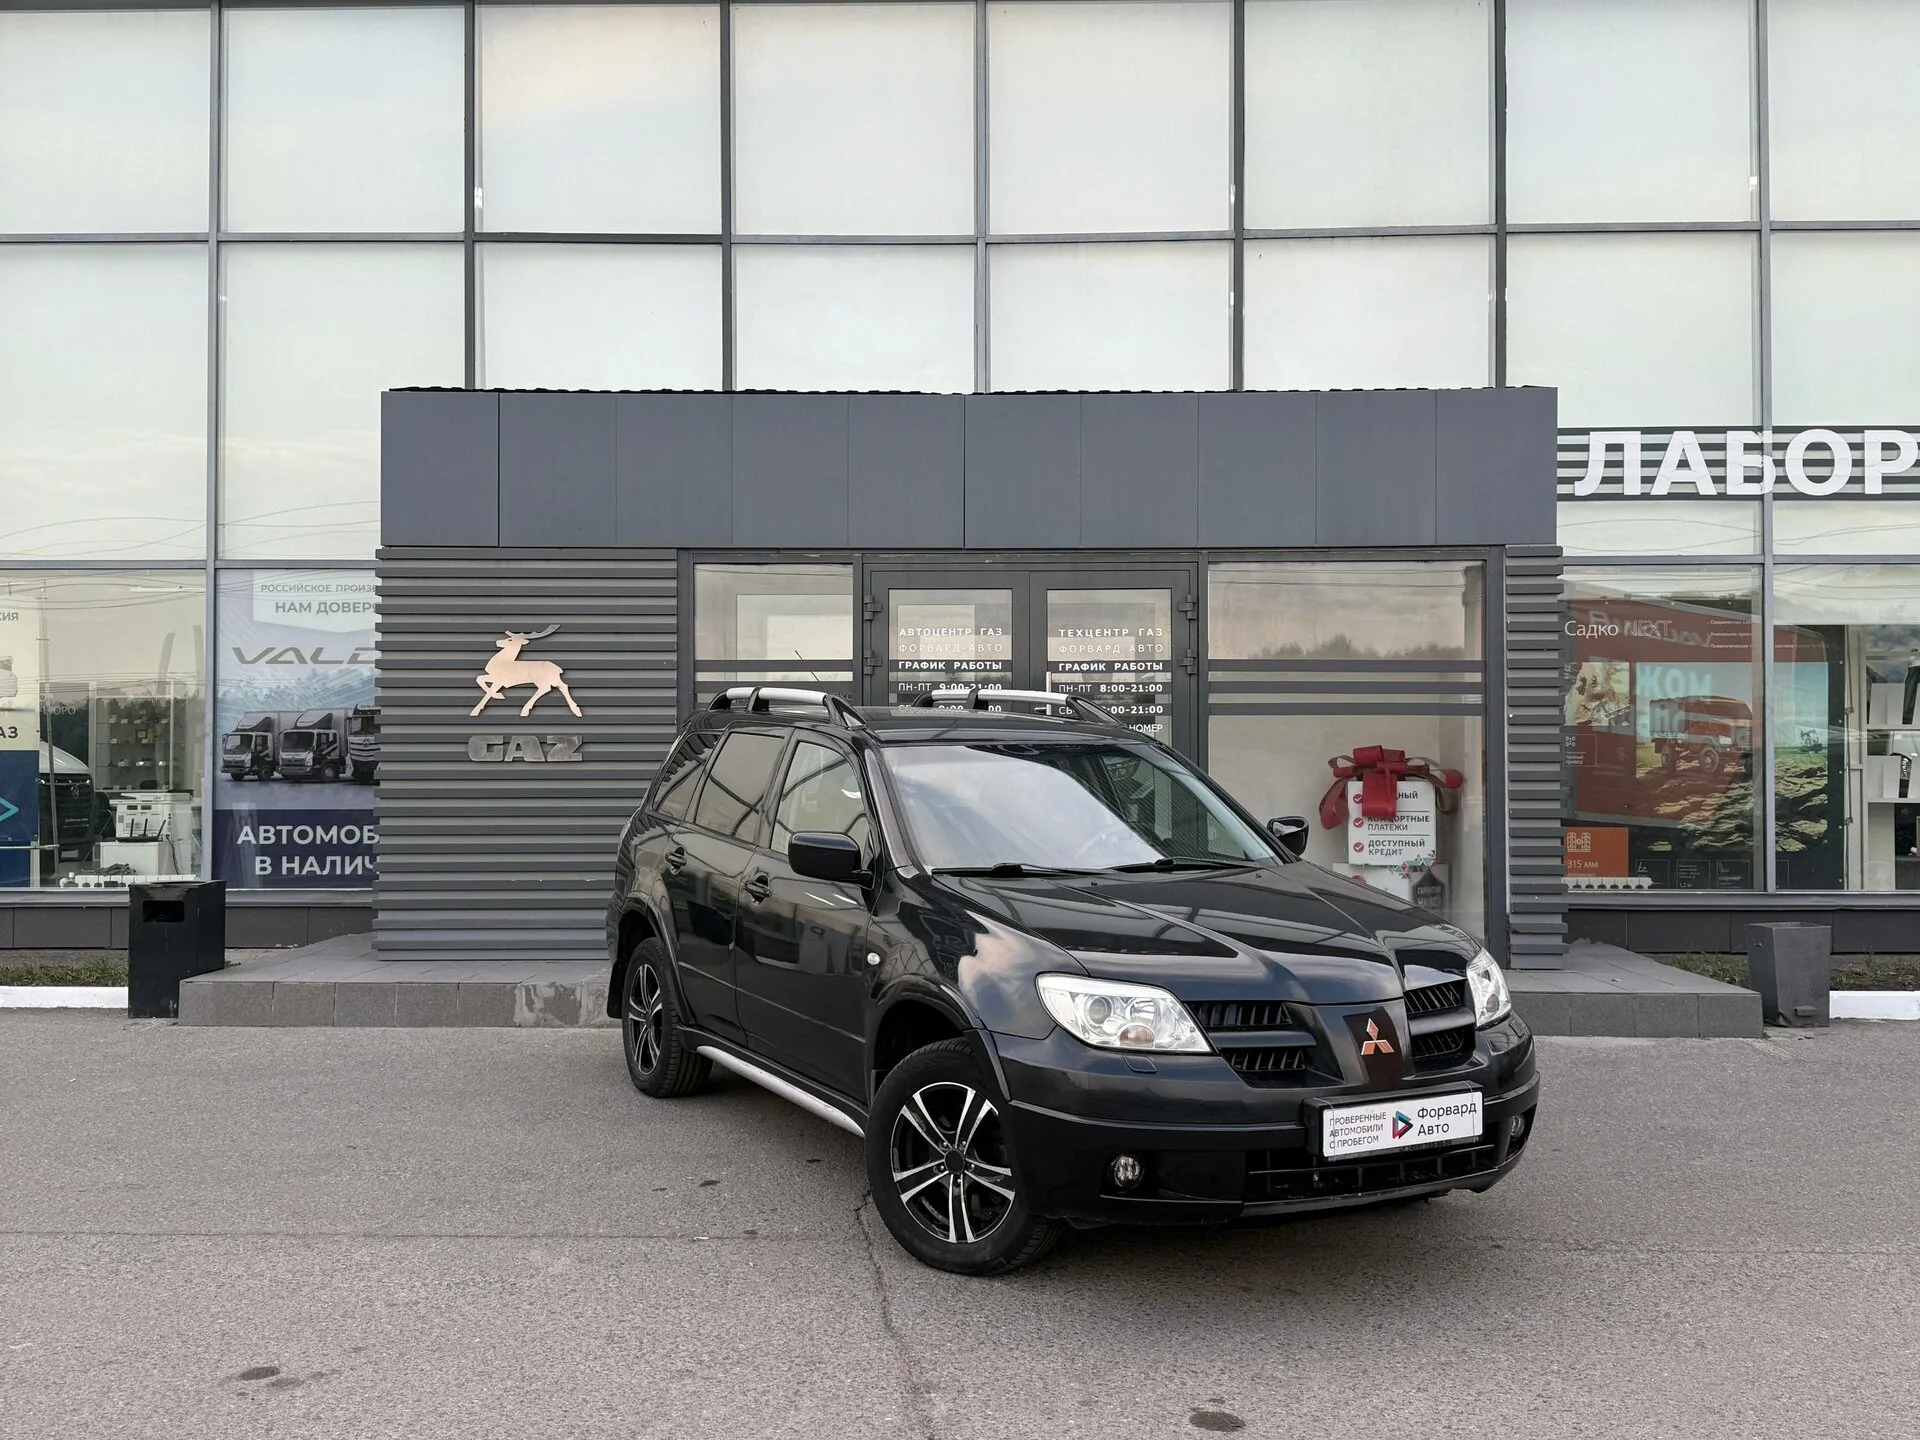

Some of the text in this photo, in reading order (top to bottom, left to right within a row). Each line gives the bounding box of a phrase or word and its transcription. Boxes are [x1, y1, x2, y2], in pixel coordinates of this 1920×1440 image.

[1574, 428, 1919, 497] ЛАБОР
[261, 583, 331, 593] РОССИЙСКОЕ
[275, 602, 312, 613] НАМ
[899, 628, 1002, 637] АВТОЦЕНТР ГАЗ
[1059, 628, 1163, 638] ТЕХЦЕНТР ГАЗ
[1564, 619, 1672, 639] Садко NEXT
[1059, 644, 1163, 654] ФОРВАРД АВТО
[898, 661, 1002, 670] ГРАФИК РАБОТЫ
[1058, 662, 1163, 672] ГРАФИК РАБОТЫ
[898, 683, 932, 692] ПН-ПТ
[1058, 684, 1163, 693] ПН-ПТ 8:00-21:00
[468, 734, 583, 762] GAZ
[1367, 823, 1408, 831] ПЛАТЕЖИ
[1368, 838, 1425, 848] ДОСТУПНЫЙ
[1368, 848, 1403, 857] КРЕДИТ
[255, 856, 273, 875] В
[1567, 859, 1582, 868] 315
[1417, 1102, 1477, 1121] Форвард
[1329, 1111, 1387, 1126] ПРОВЕРЕННЫЕ
[1329, 1123, 1384, 1138] АВТОМОБИЛИ
[1417, 1122, 1450, 1137] Авто
[1337, 1135, 1379, 1149] ПРОБЕГОМ
